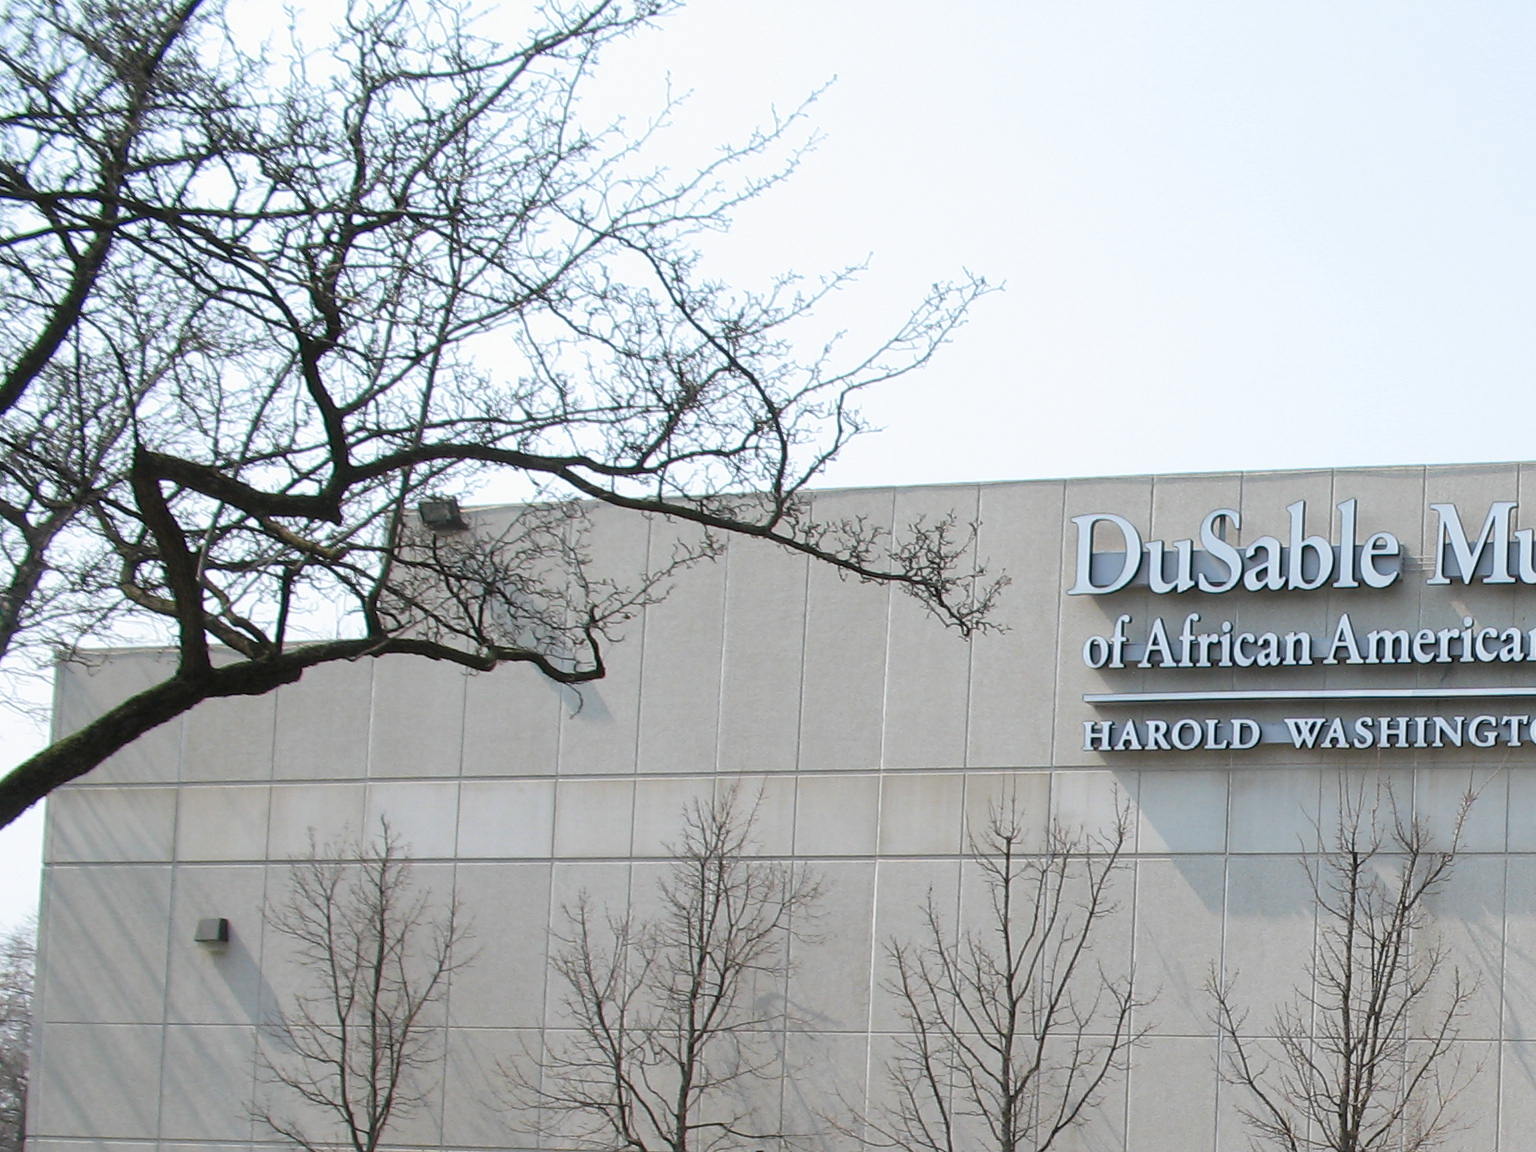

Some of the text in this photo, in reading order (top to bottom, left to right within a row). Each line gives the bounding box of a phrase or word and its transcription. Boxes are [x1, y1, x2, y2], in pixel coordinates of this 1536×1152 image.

[1067, 498, 1401, 596] DuSable
[1082, 614, 1131, 669] of
[1137, 612, 1313, 668] African
[1082, 717, 1261, 751] HAROLD
